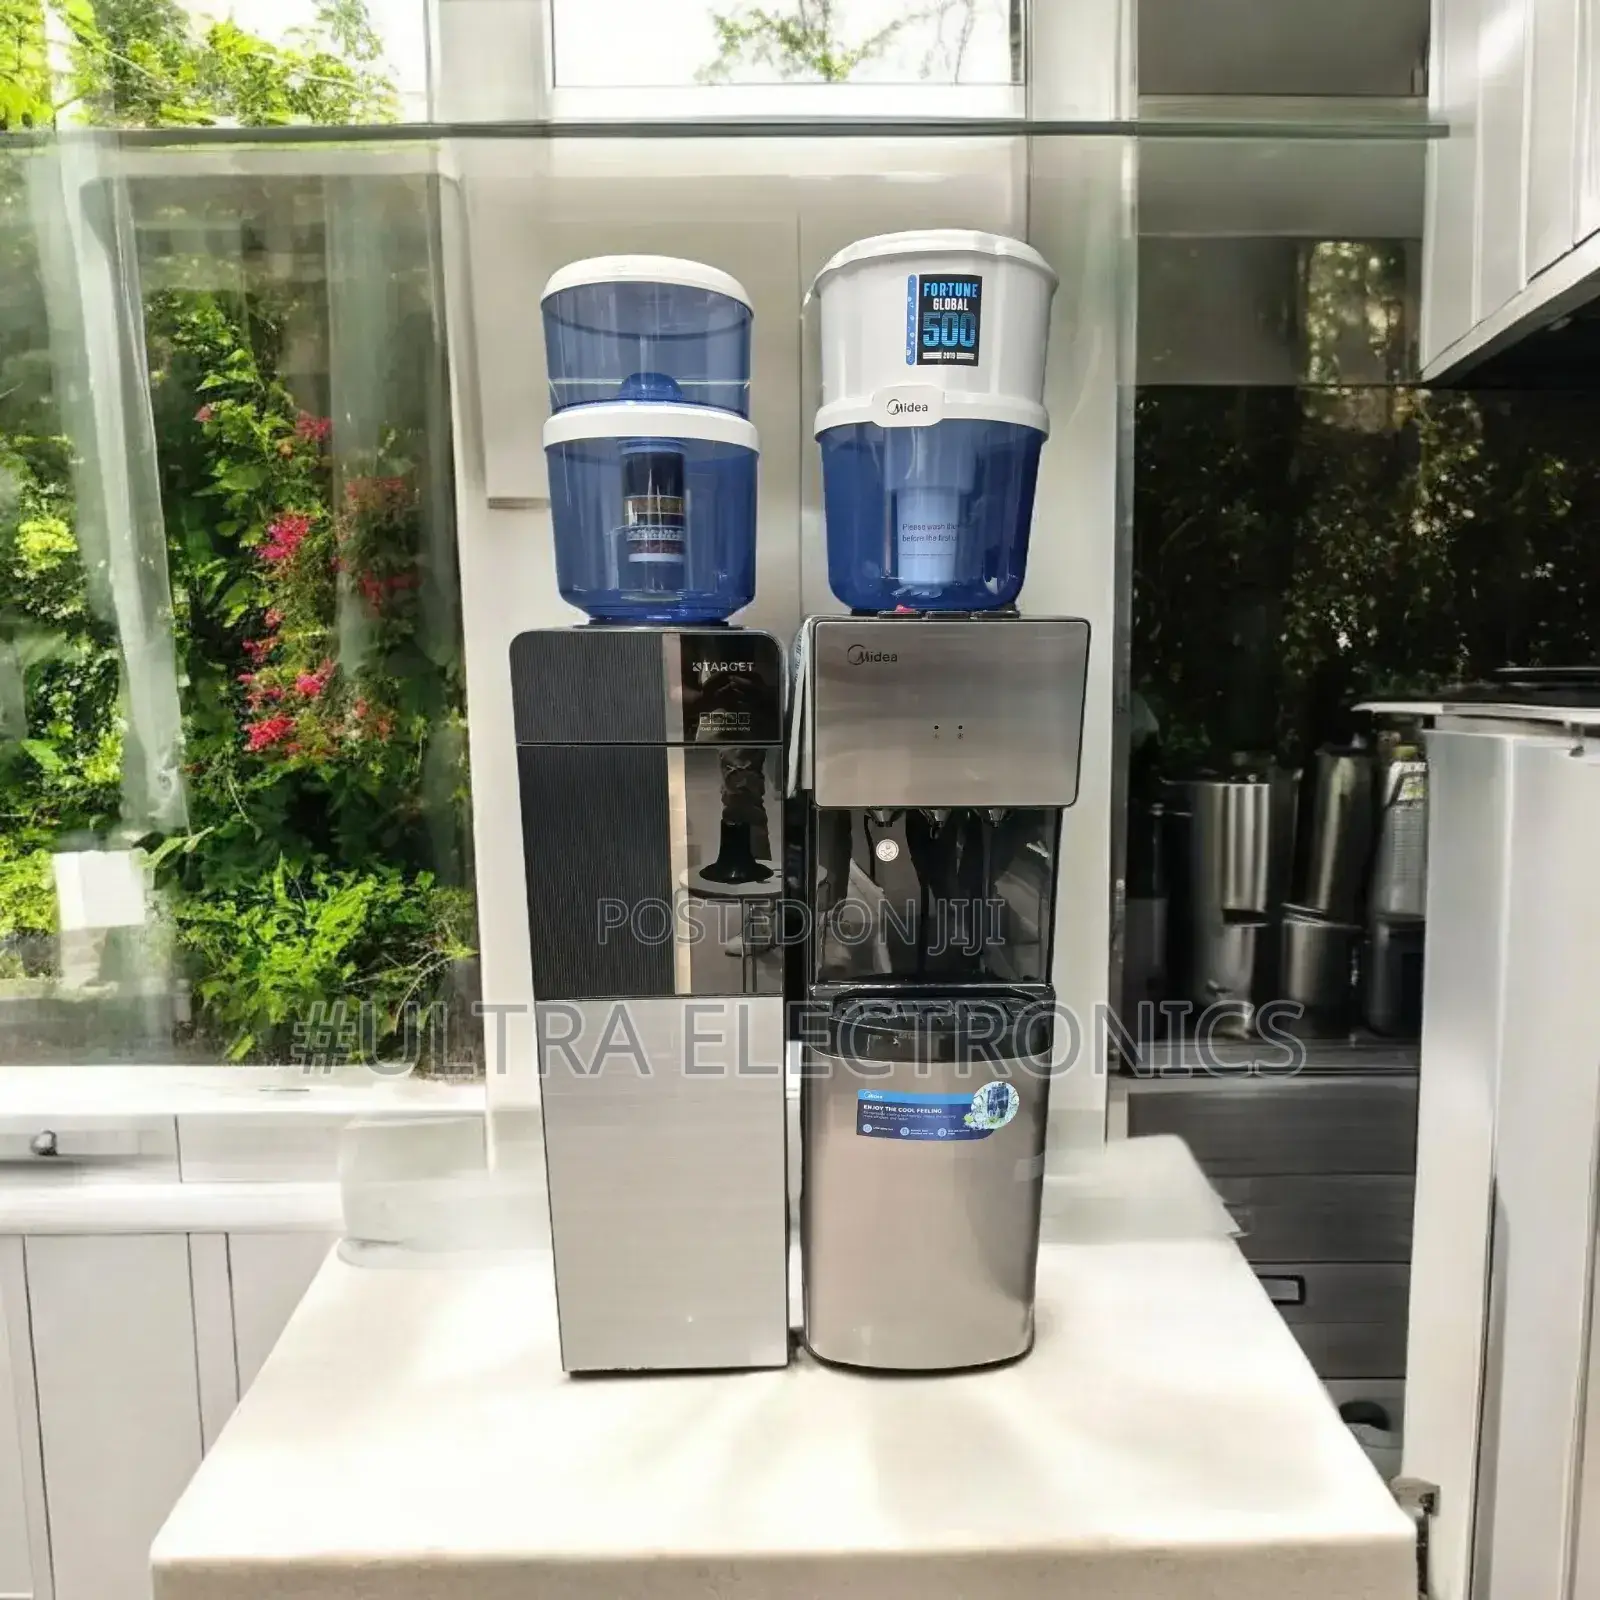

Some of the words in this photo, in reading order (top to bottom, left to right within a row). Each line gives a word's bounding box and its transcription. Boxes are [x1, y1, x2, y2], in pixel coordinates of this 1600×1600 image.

[923, 282, 979, 298] FORTUNE
[933, 297, 969, 311] GLOBAL
[922, 311, 976, 347] 500
[887, 398, 929, 415] Midea
[902, 523, 926, 531] Please
[902, 534, 924, 542] before
[926, 534, 937, 542] the
[847, 644, 898, 666] Midea
[703, 661, 754, 672] TARGET
